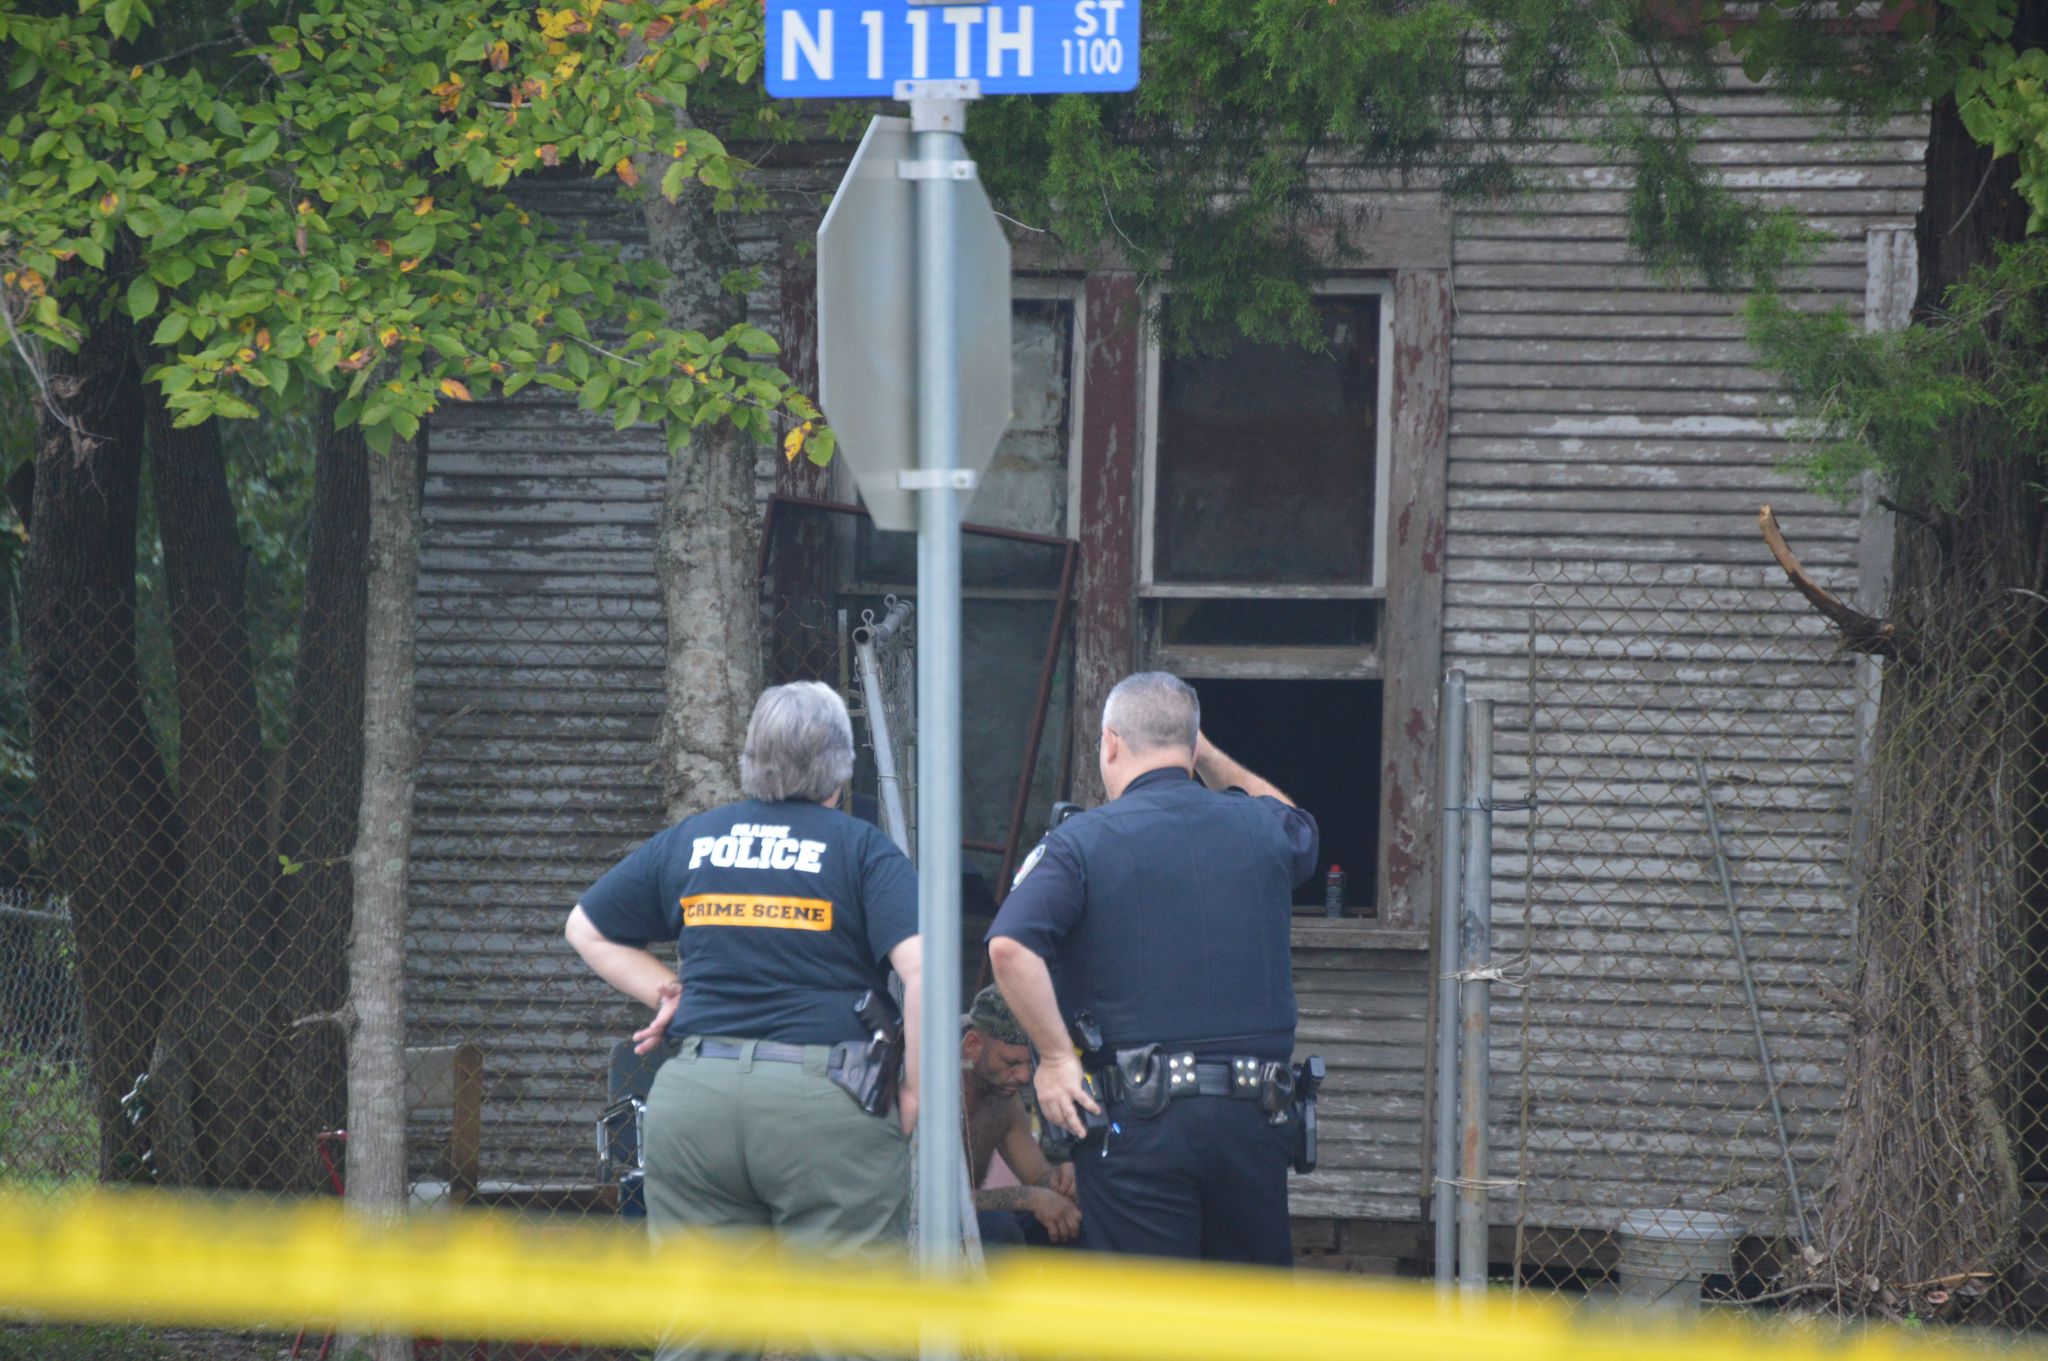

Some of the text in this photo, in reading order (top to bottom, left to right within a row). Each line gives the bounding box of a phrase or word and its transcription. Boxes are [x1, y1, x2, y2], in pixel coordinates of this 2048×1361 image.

[1074, 0, 1124, 36] ST
[781, 6, 1034, 80] N 11TH
[1062, 38, 1122, 76] 1100
[688, 836, 827, 873] POLICE
[687, 902, 825, 922] CRIME SCENE
